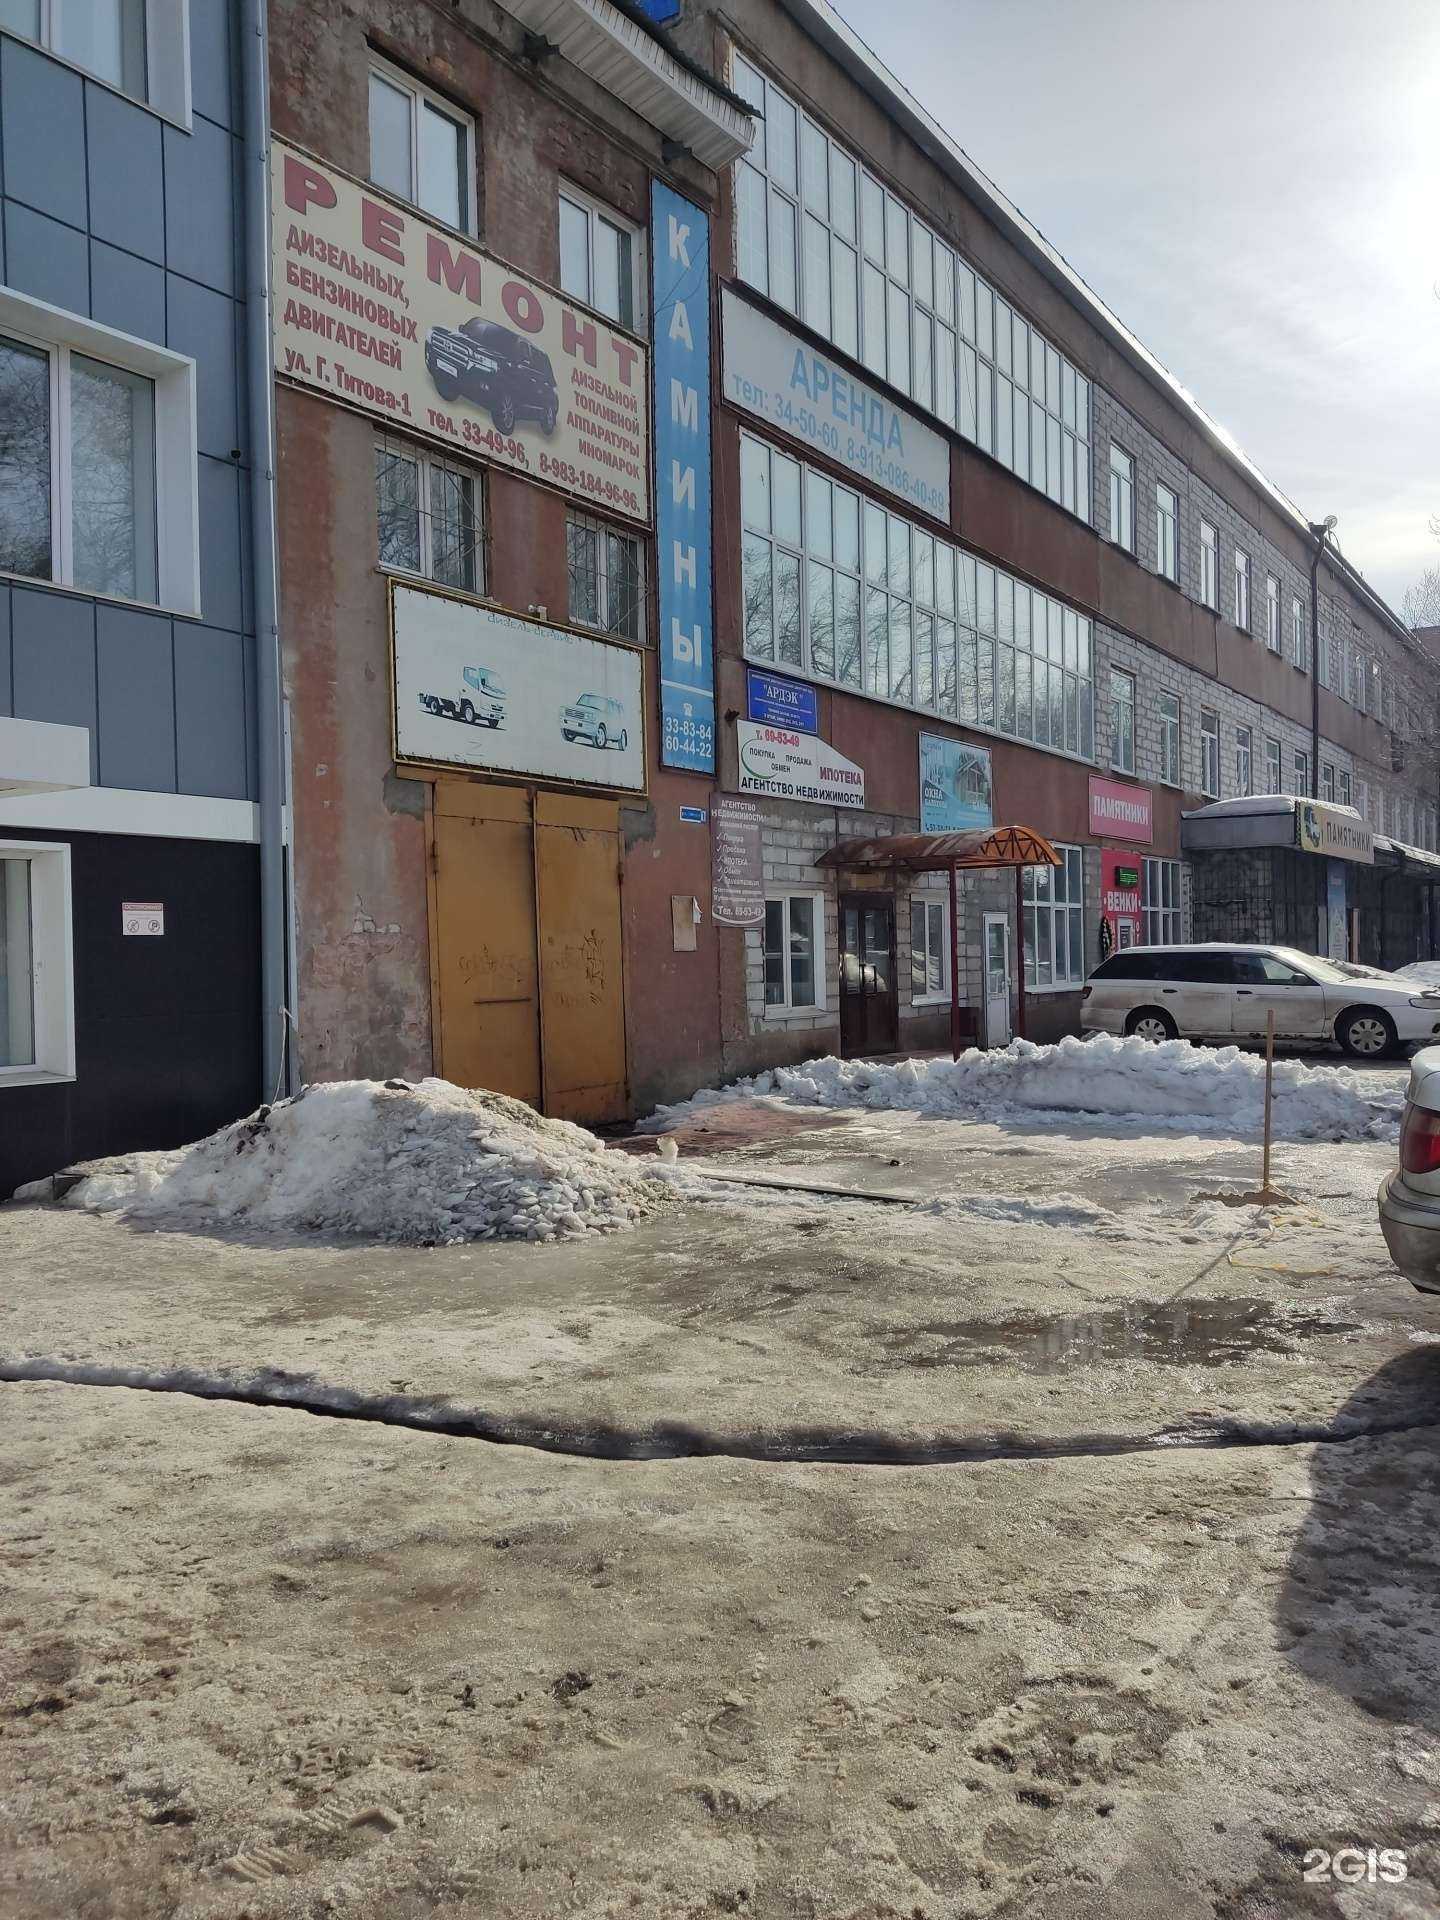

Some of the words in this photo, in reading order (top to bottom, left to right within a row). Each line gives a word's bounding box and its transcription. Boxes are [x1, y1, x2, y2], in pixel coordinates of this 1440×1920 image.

[284, 154, 638, 387] РЕМОНТ
[285, 224, 411, 310] ДИЗЕЛЬНЫХ,
[286, 260, 418, 343] БЕНЗИНОВЫХ
[284, 299, 403, 370] ДВИГАТЕЛЕЙ
[284, 347, 311, 375] ул.
[316, 355, 330, 383] Г.
[334, 361, 412, 418] Титова-1
[571, 367, 638, 413] ДИЗЕЛЬНОЙ
[732, 373, 768, 412] тел:
[790, 348, 904, 458] АРЕНДА
[566, 411, 640, 458] АППАРАТУРЫ
[574, 391, 640, 437] ТОПЛИВНОЙ
[428, 408, 458, 438] тел.
[462, 418, 529, 469] 33-49-96,
[667, 214, 703, 670] КАМИНЫ
[579, 438, 640, 481] ИНОМАРОК
[665, 716, 712, 741] 33-83-84
[665, 735, 712, 758] 60-44-22
[749, 747, 776, 760] ПОКУПКА
[770, 762, 791, 773] ОБМЕН
[785, 754, 812, 766] ПРОДАЖА
[741, 776, 794, 795] АГЕНТСТВО
[796, 785, 864, 805] НЕДВИЖИМОСТИ
[819, 766, 862, 786] ИПОТЕКА
[924, 787, 943, 801] ОКНА
[1092, 794, 1149, 825] ПАМЯТНИКИ
[1326, 822, 1371, 853] ПАМЯТНИКИ
[1107, 890, 1138, 913] ВЕНКИ
